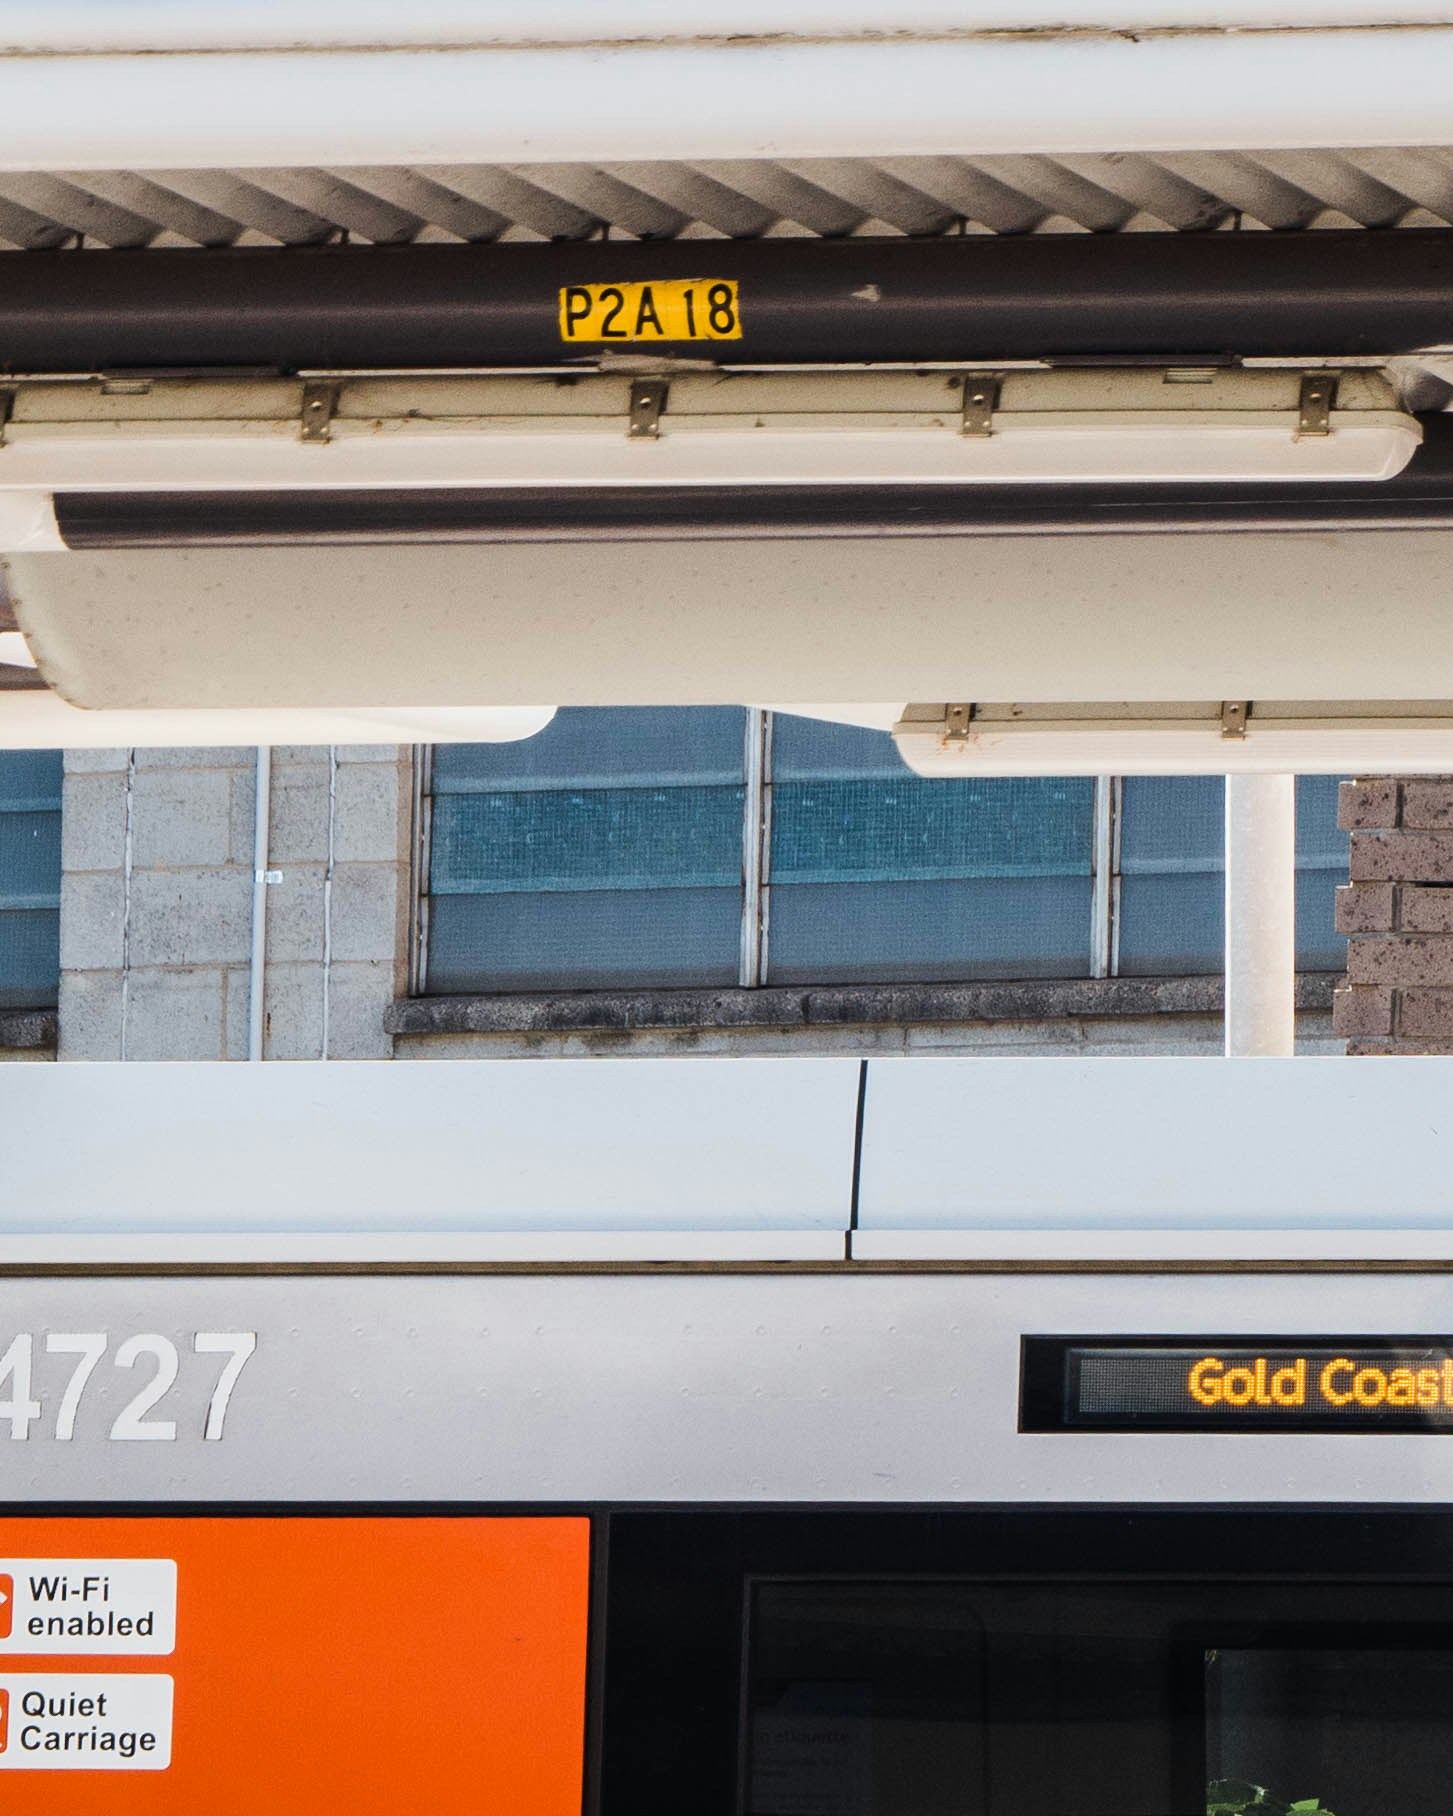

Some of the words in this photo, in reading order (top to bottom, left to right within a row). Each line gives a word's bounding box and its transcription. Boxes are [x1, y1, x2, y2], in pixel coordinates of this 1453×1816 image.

[0, 1332, 258, 1441] 4727
[1188, 1356, 1306, 1406] Gold
[29, 1576, 110, 1602] Wi-Fi
[27, 1611, 154, 1637] enabled
[21, 1691, 107, 1718] Quiet
[20, 1725, 156, 1758] Carriage
